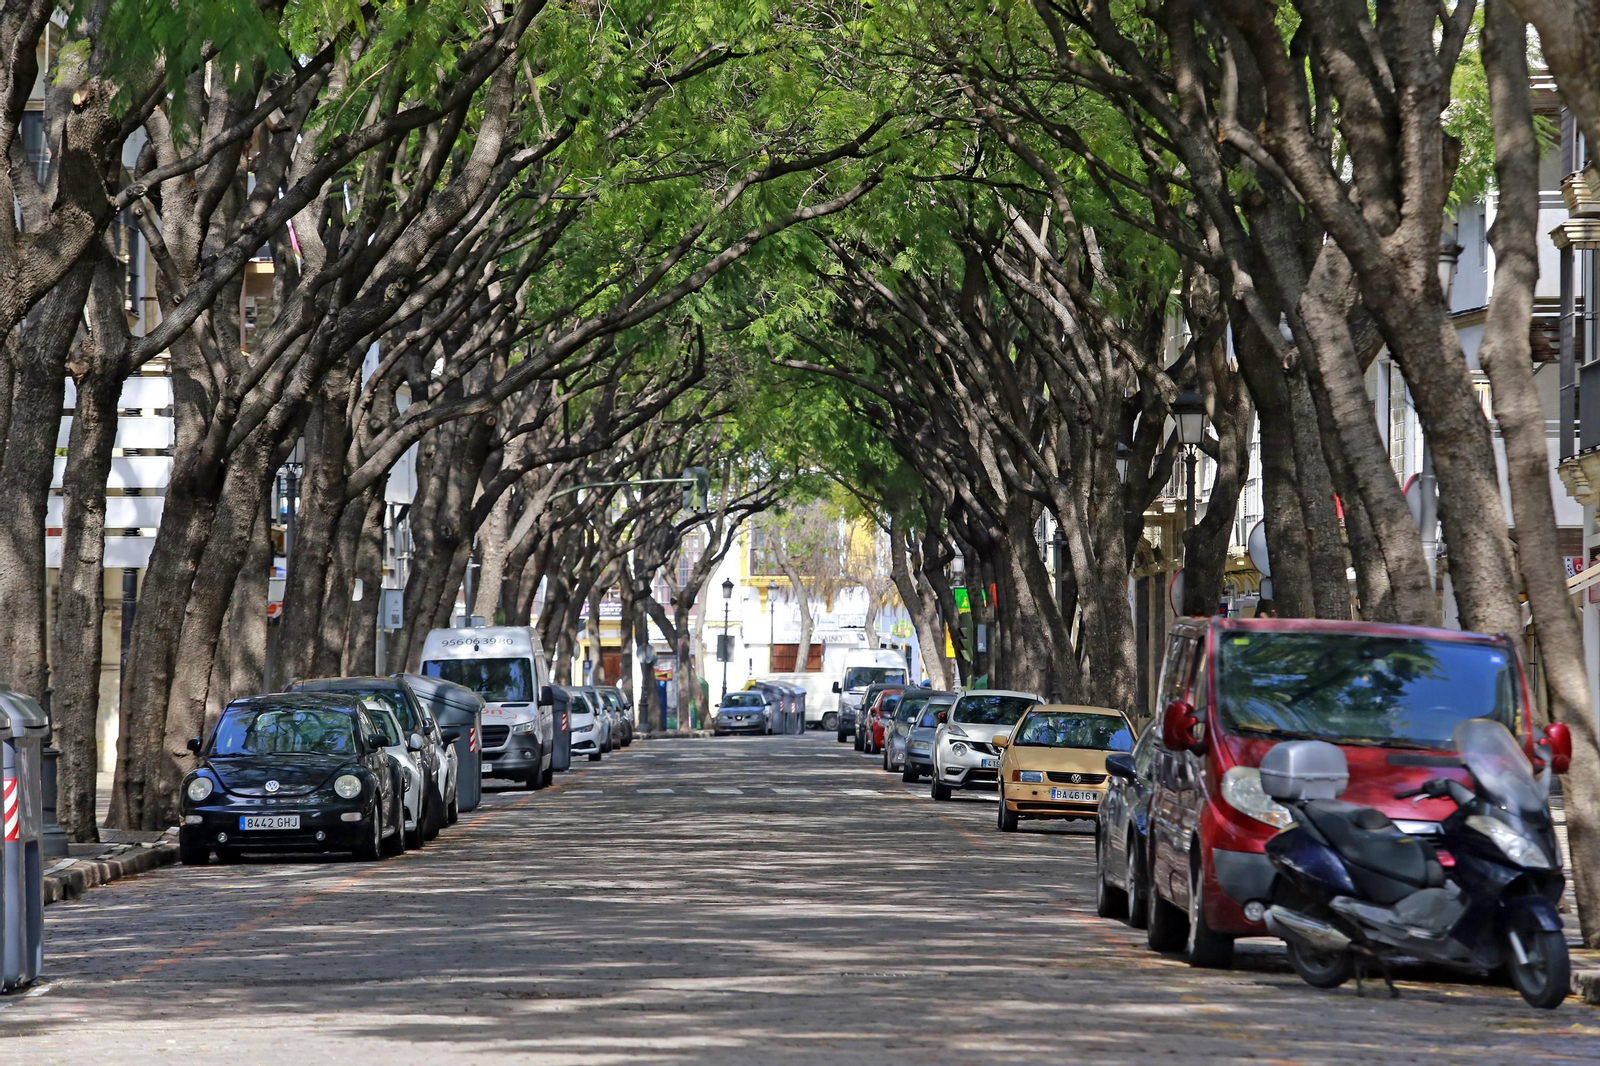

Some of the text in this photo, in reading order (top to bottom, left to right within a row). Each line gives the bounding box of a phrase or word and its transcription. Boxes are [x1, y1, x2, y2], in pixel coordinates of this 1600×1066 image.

[442, 638, 464, 647] 956
[1068, 791, 1091, 800] 4616
[247, 817, 298, 828] 8442 GHJ
